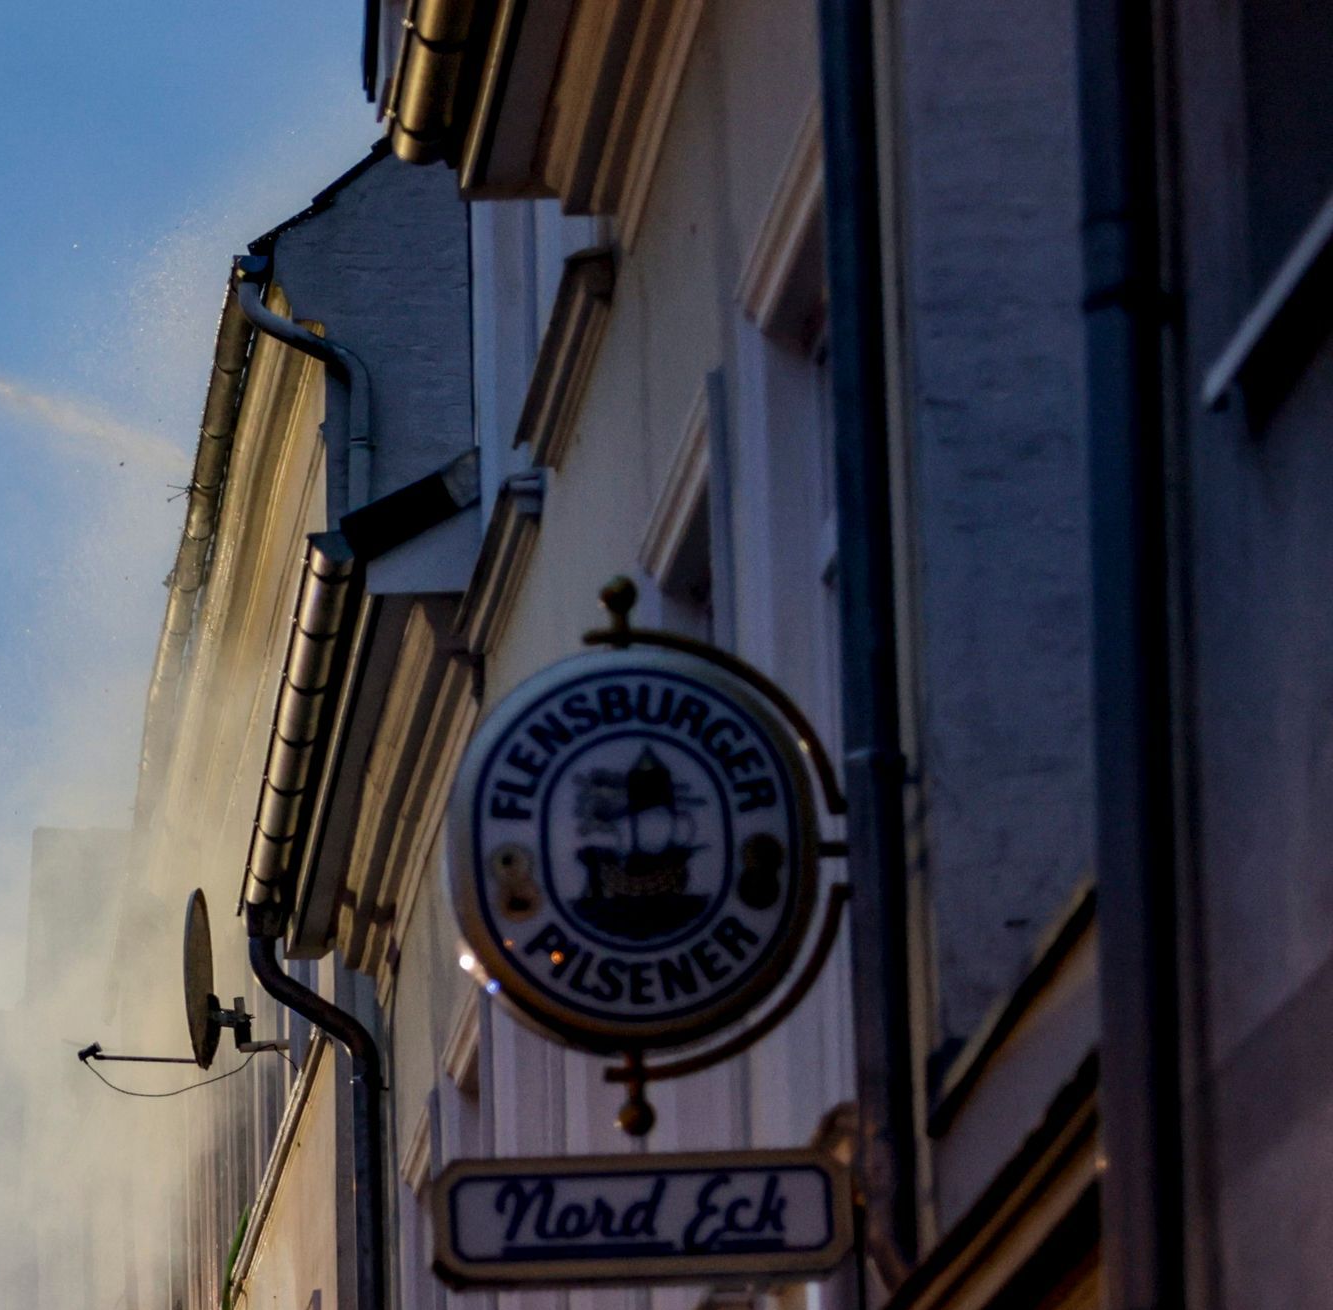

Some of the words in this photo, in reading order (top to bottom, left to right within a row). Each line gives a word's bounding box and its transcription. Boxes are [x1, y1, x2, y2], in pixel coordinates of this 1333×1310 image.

[490, 683, 778, 821] FLENSBURGER
[525, 916, 760, 1005] PILSENER
[494, 1174, 668, 1243] Nord
[682, 1172, 789, 1256] Eck
